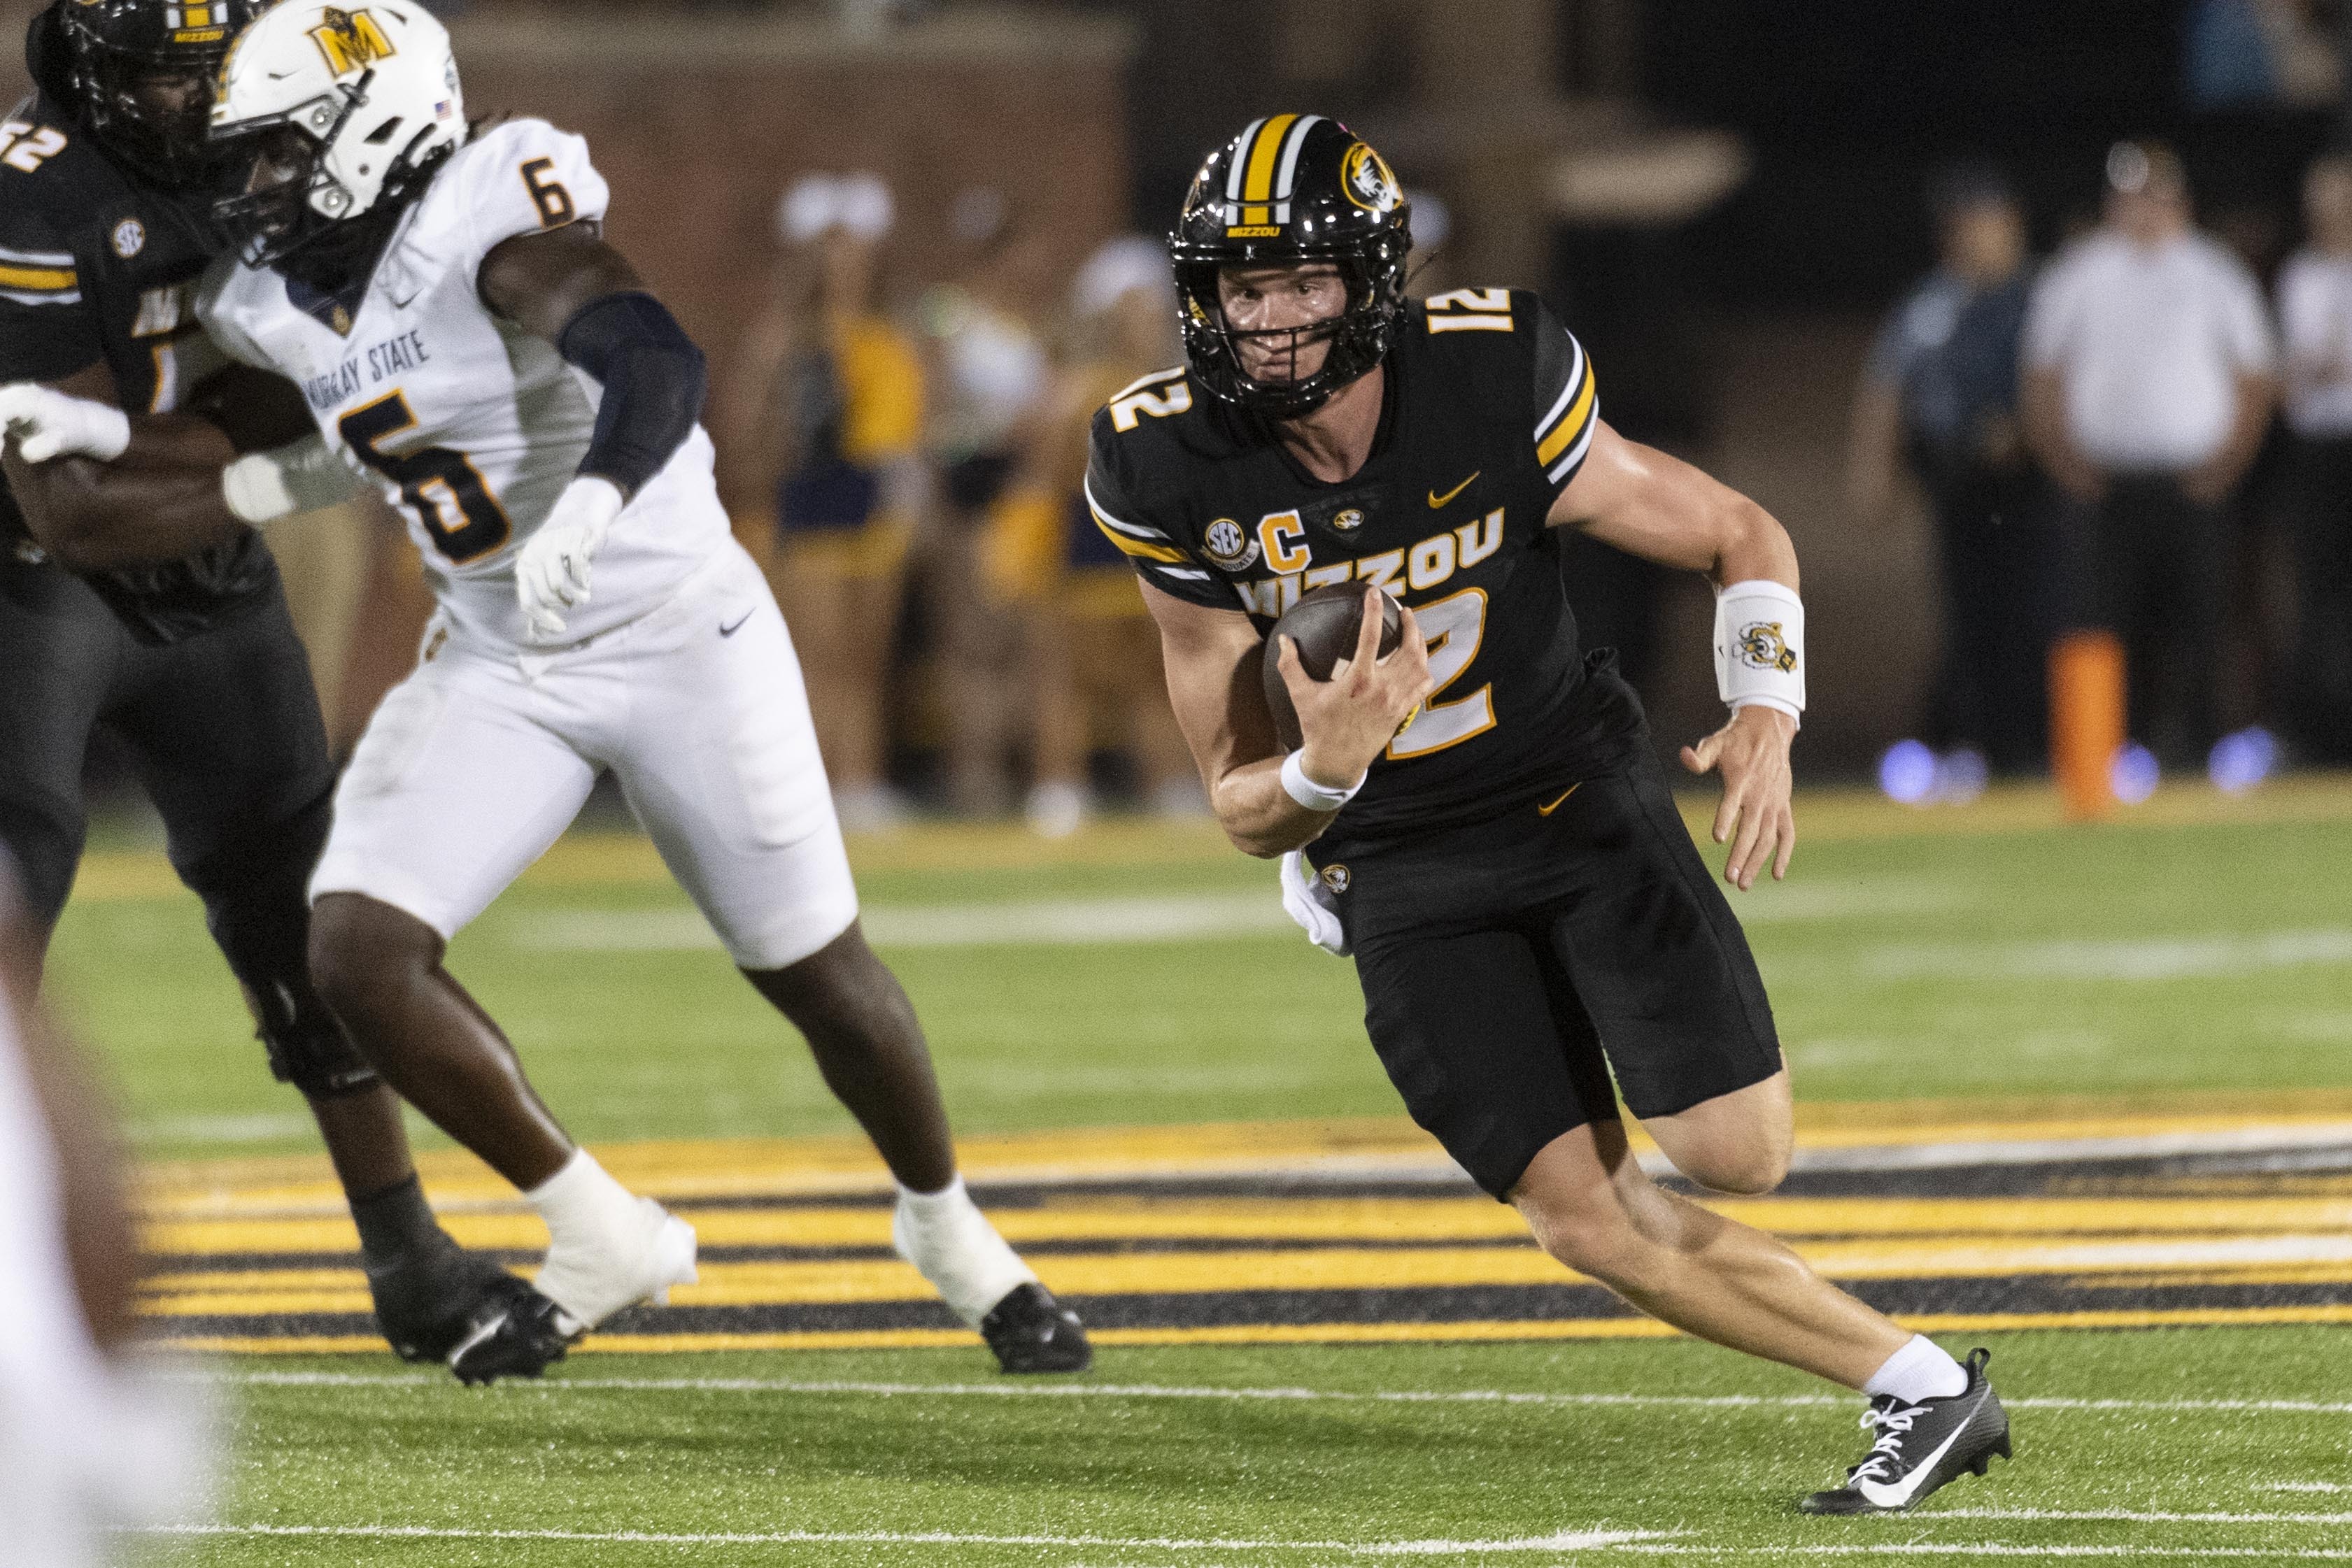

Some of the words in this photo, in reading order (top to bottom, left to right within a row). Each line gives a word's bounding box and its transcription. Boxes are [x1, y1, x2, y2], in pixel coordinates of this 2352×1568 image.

[519, 155, 576, 231] 6
[1227, 226, 1281, 238] MIZZOU
[1425, 287, 1514, 335] 12
[368, 329, 431, 383] STATE
[1109, 365, 1193, 434] 12
[336, 387, 513, 566] 6
[1208, 521, 1242, 555] SEC
[1256, 508, 1313, 576] C
